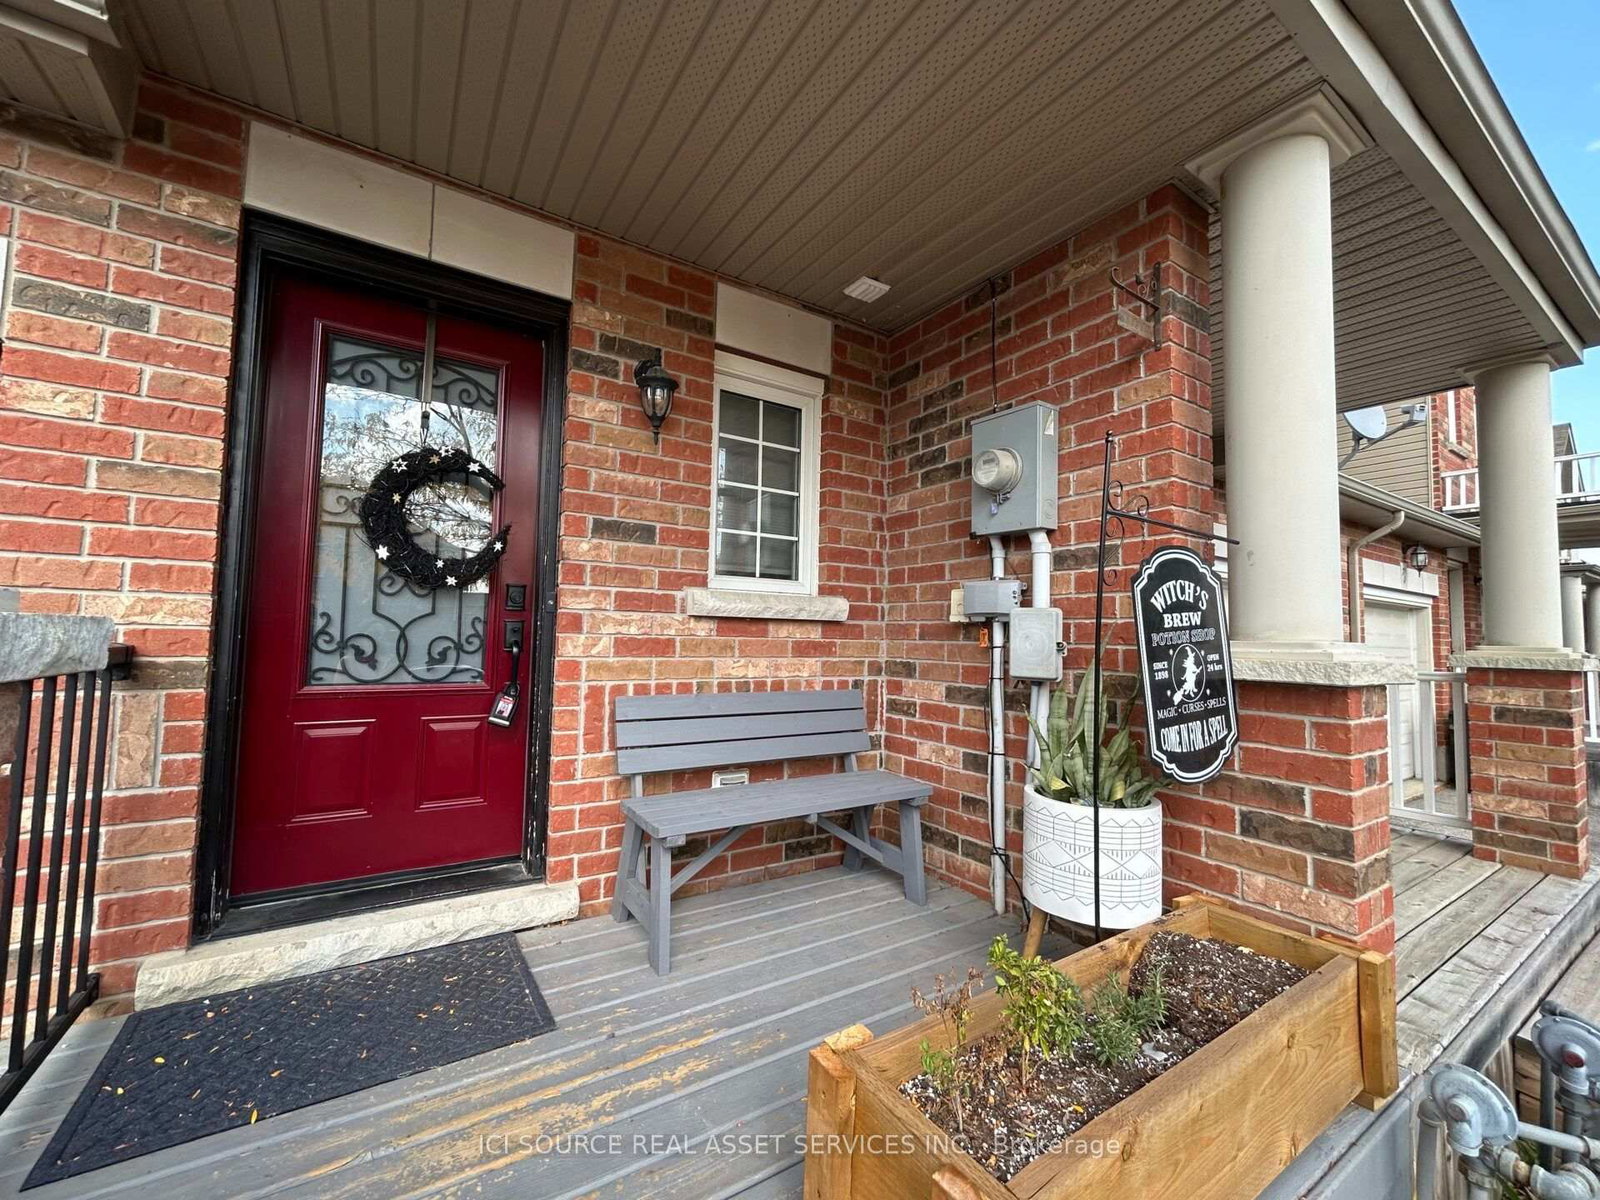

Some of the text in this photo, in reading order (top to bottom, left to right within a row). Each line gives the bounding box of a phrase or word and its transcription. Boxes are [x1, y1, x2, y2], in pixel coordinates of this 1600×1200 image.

[1150, 579, 1209, 613] WITCH'S
[1163, 611, 1202, 628] BREW
[1151, 627, 1216, 647] POTION SHOP
[1152, 661, 1169, 671] SINCE
[1206, 653, 1220, 662] OPEN
[1206, 663, 1214, 672] 24
[1157, 696, 1227, 720] MAGIC CURSES SPELLS
[1160, 714, 1229, 753] COME IN FOR A SPELL
